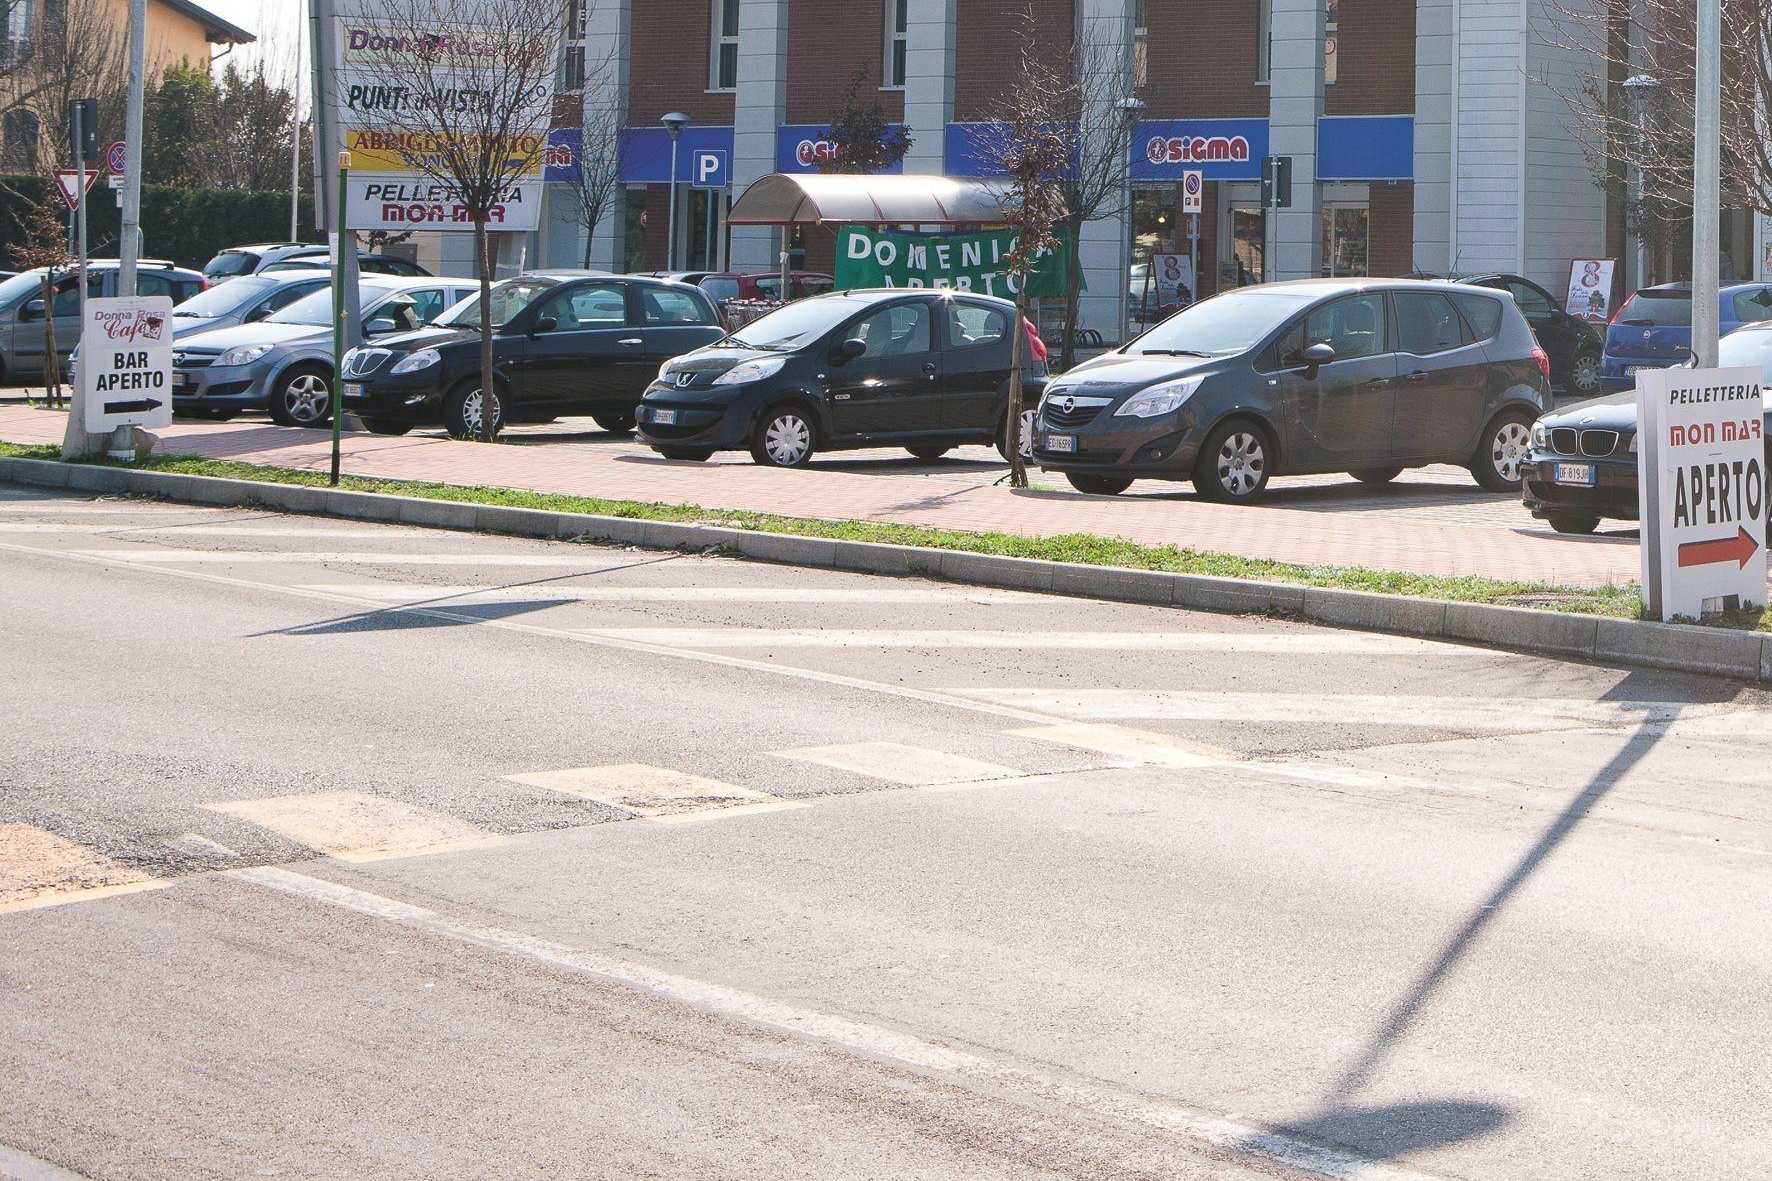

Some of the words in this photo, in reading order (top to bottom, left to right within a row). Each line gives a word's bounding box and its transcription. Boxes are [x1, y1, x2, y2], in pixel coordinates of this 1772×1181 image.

[700, 154, 719, 182] P
[452, 205, 506, 223] MR
[1164, 256, 1180, 280] 8
[1581, 261, 1600, 288] 8
[94, 311, 133, 321] Donna
[137, 309, 166, 319] Rosa
[114, 351, 149, 370] BAR
[95, 370, 164, 392] APERTO
[1670, 384, 1760, 405] PELLETTERIA
[1670, 422, 1715, 447] MON
[1721, 419, 1761, 442] MAR
[1674, 457, 1762, 528] APERTO
